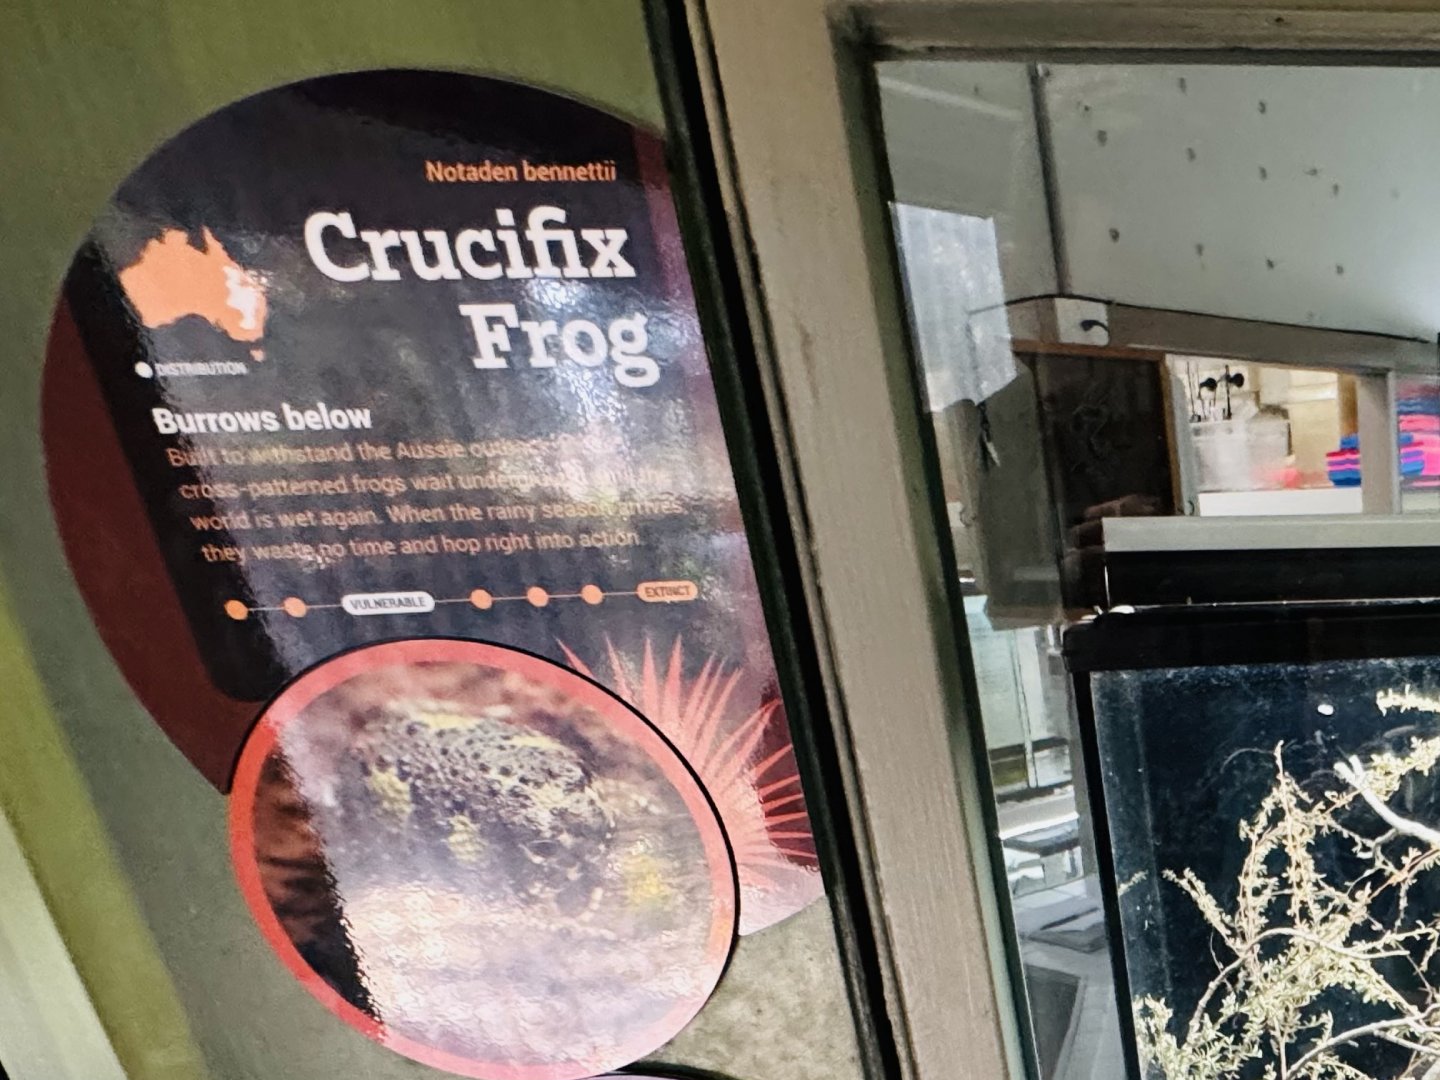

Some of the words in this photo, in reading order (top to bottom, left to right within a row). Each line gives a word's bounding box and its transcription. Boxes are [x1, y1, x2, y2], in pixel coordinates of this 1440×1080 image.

[425, 160, 518, 182] Notaden
[522, 159, 617, 182] bennettii
[304, 205, 636, 282] Crucifix
[458, 302, 661, 388] Frog
[155, 361, 248, 376] DISTRIBUTION
[152, 407, 280, 434] Burrows
[282, 402, 373, 430] below
[223, 446, 245, 465] to
[248, 441, 352, 466] withstand
[357, 441, 392, 461] the
[398, 440, 466, 459] Aussie
[180, 475, 346, 499] cross-patterned
[352, 473, 407, 497] frogs
[410, 472, 455, 491] wait
[190, 508, 249, 530] world
[255, 510, 273, 528] is
[278, 507, 316, 528] wet
[321, 508, 384, 531] again.
[386, 503, 445, 523] When
[449, 502, 483, 521] the
[486, 503, 536, 523] rainy
[542, 501, 614, 518] season
[201, 543, 245, 566] they
[252, 543, 315, 560] waste
[319, 541, 345, 559] no
[349, 536, 397, 556] time
[400, 535, 438, 554] and
[440, 532, 482, 555] hop
[485, 531, 531, 555] right
[535, 529, 574, 549] into
[350, 596, 426, 610] VULNERABLE
[644, 584, 691, 597] EXTINCT
